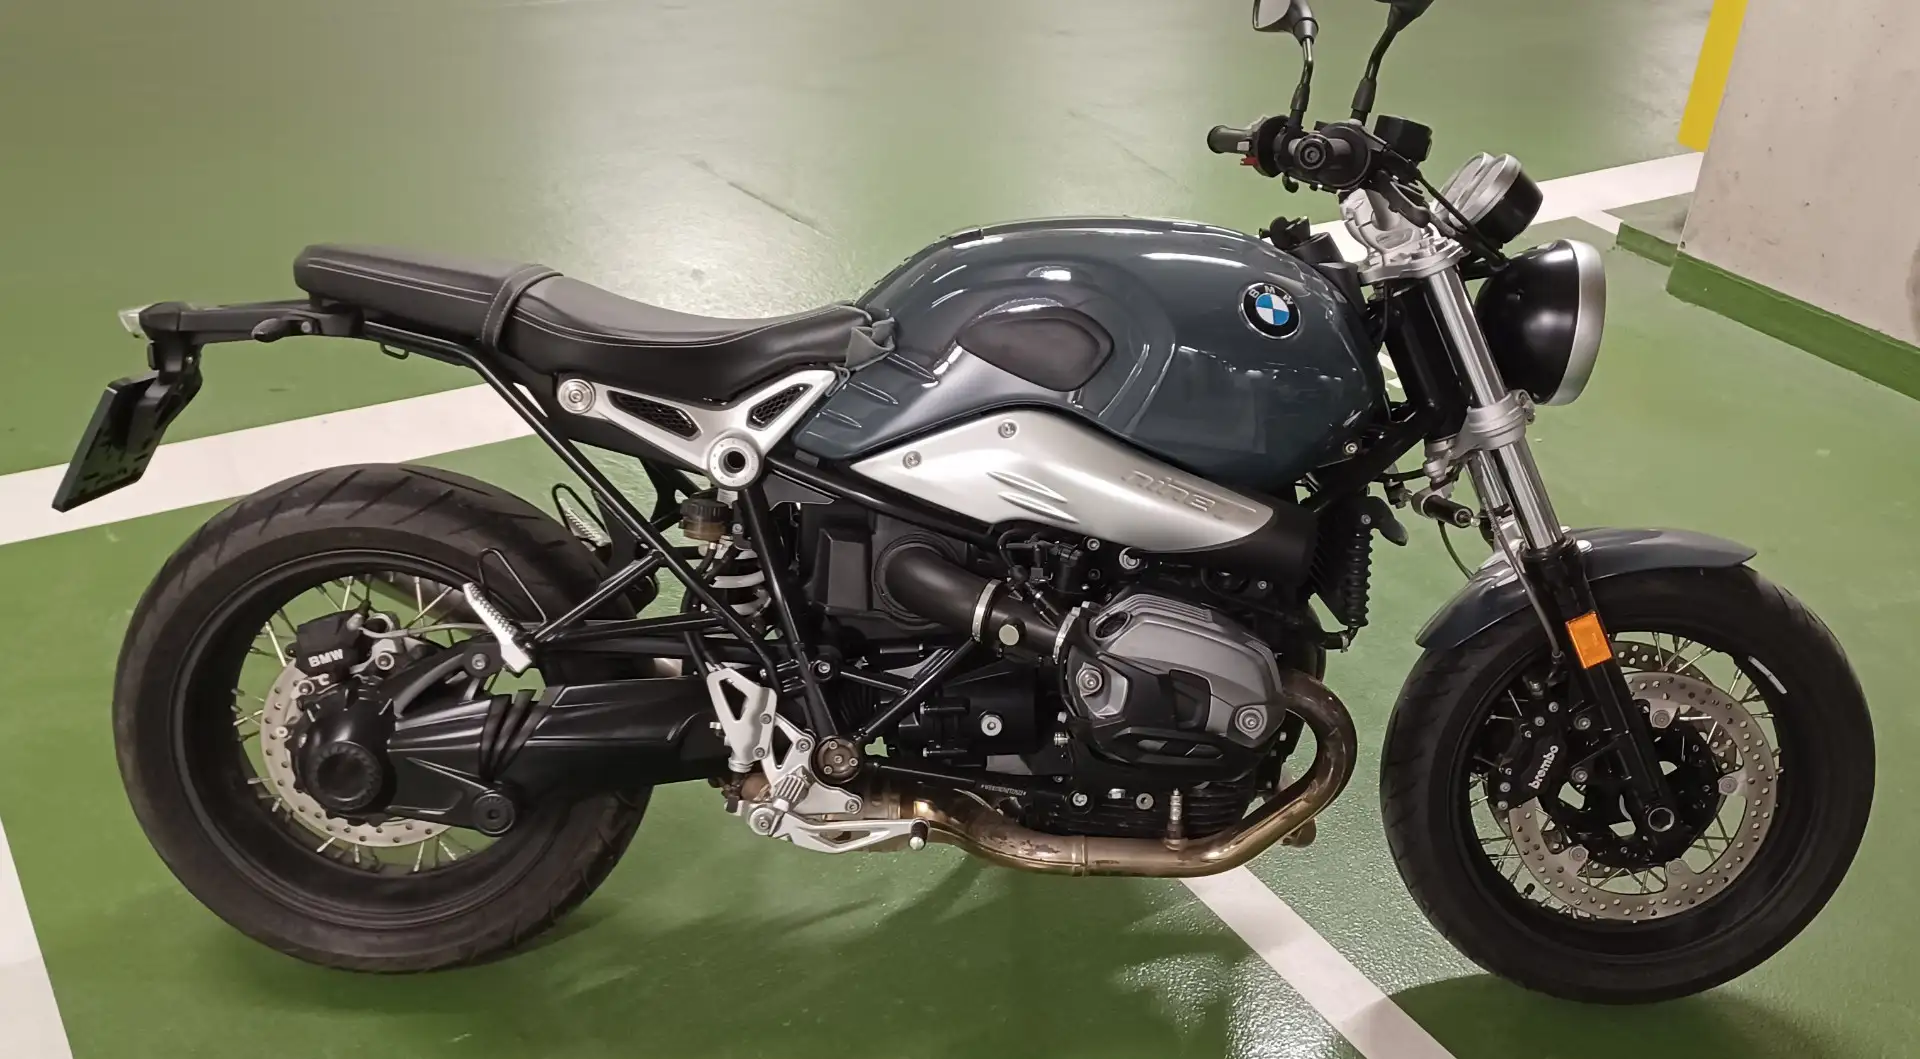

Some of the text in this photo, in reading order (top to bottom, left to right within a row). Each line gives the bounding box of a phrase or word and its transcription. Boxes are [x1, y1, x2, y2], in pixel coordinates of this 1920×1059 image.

[1248, 285, 1294, 305] BMW
[308, 648, 344, 668] BMW
[1528, 745, 1559, 790] brembo
